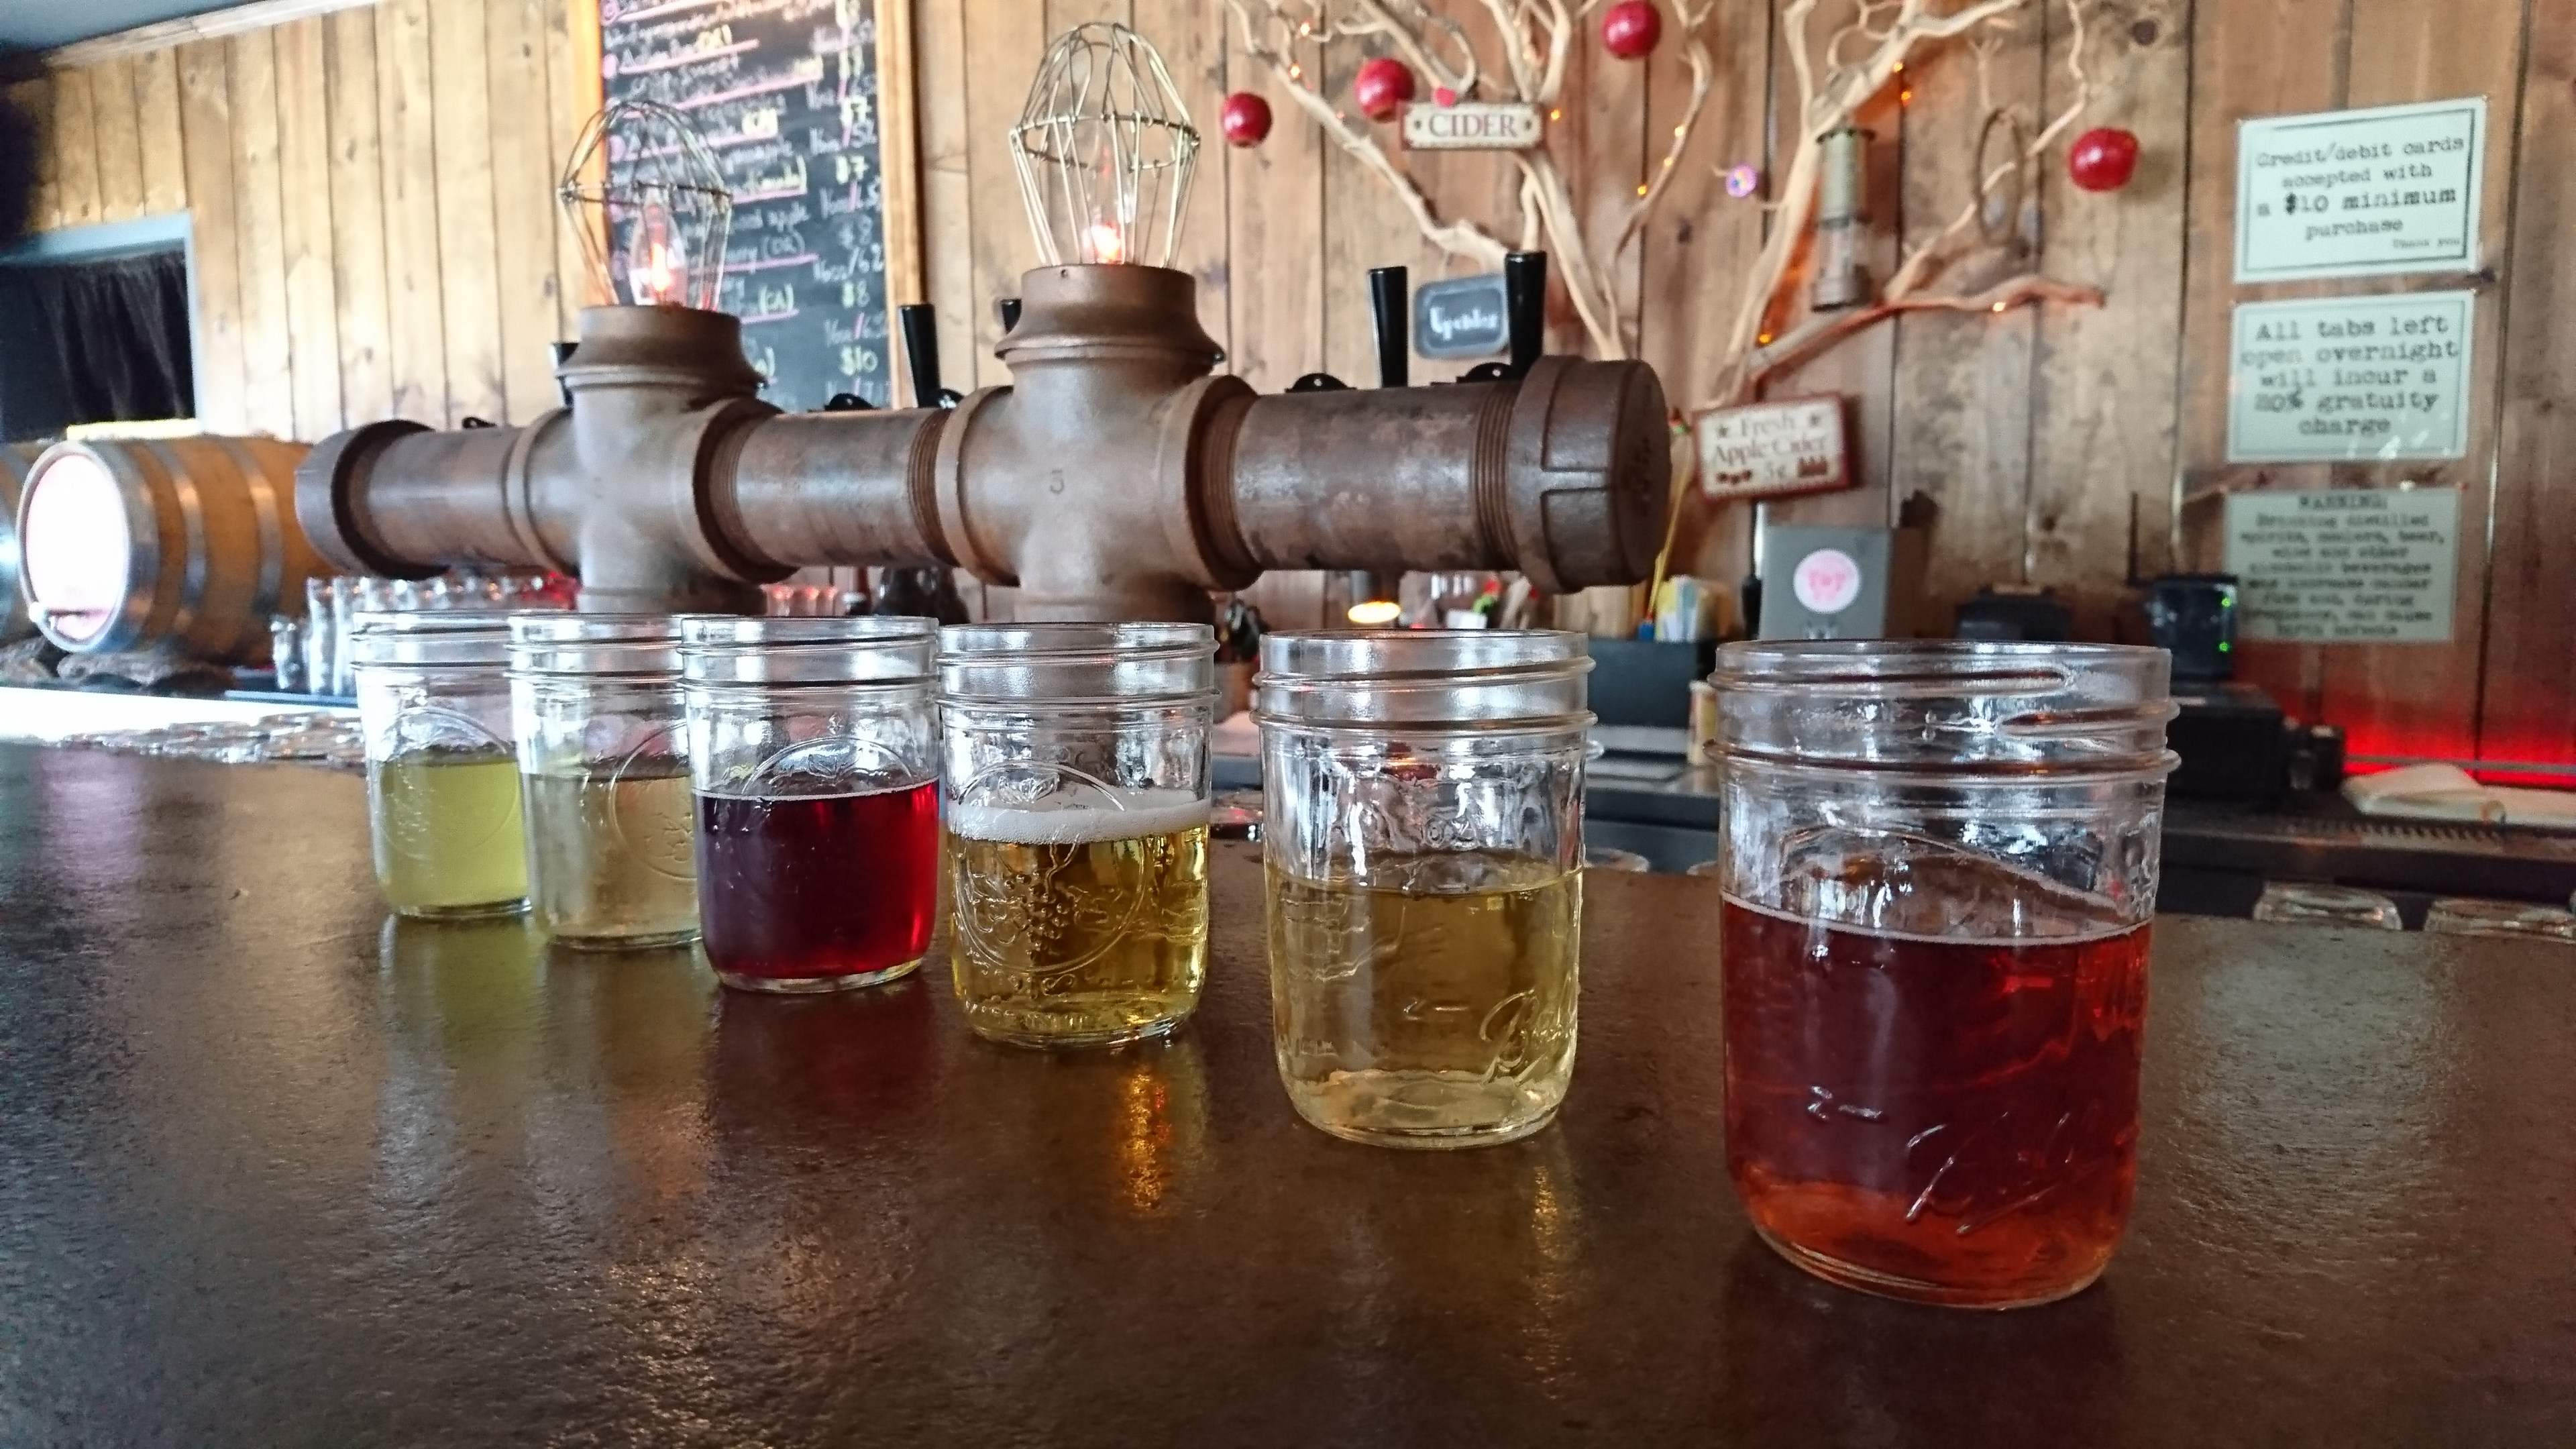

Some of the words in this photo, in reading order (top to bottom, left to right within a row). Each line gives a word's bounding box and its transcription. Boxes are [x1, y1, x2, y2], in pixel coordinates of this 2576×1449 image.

[1429, 114, 1517, 137] CIDER
[2257, 142, 2392, 167] Credit/debit
[2403, 136, 2465, 155] cards
[2282, 168, 2371, 188] accepted
[2383, 163, 2432, 180] with
[2257, 203, 2271, 217] a
[2284, 192, 2329, 215] $10
[2342, 189, 2457, 209] minimum
[2306, 219, 2404, 241] purchase
[2255, 320, 2301, 341] All
[2317, 319, 2375, 338] tabs
[2390, 315, 2449, 335] left
[2241, 348, 2302, 370] open
[2316, 340, 2460, 363] overnight
[2260, 368, 2316, 387] will
[2334, 368, 2409, 386] incur
[2422, 369, 2437, 384] a
[2316, 392, 2439, 413] gratuity
[1740, 412, 1796, 437] Fresh
[2298, 418, 2392, 437] charge
[1712, 438, 1764, 467] Apple
[1772, 431, 1827, 456] Cider
